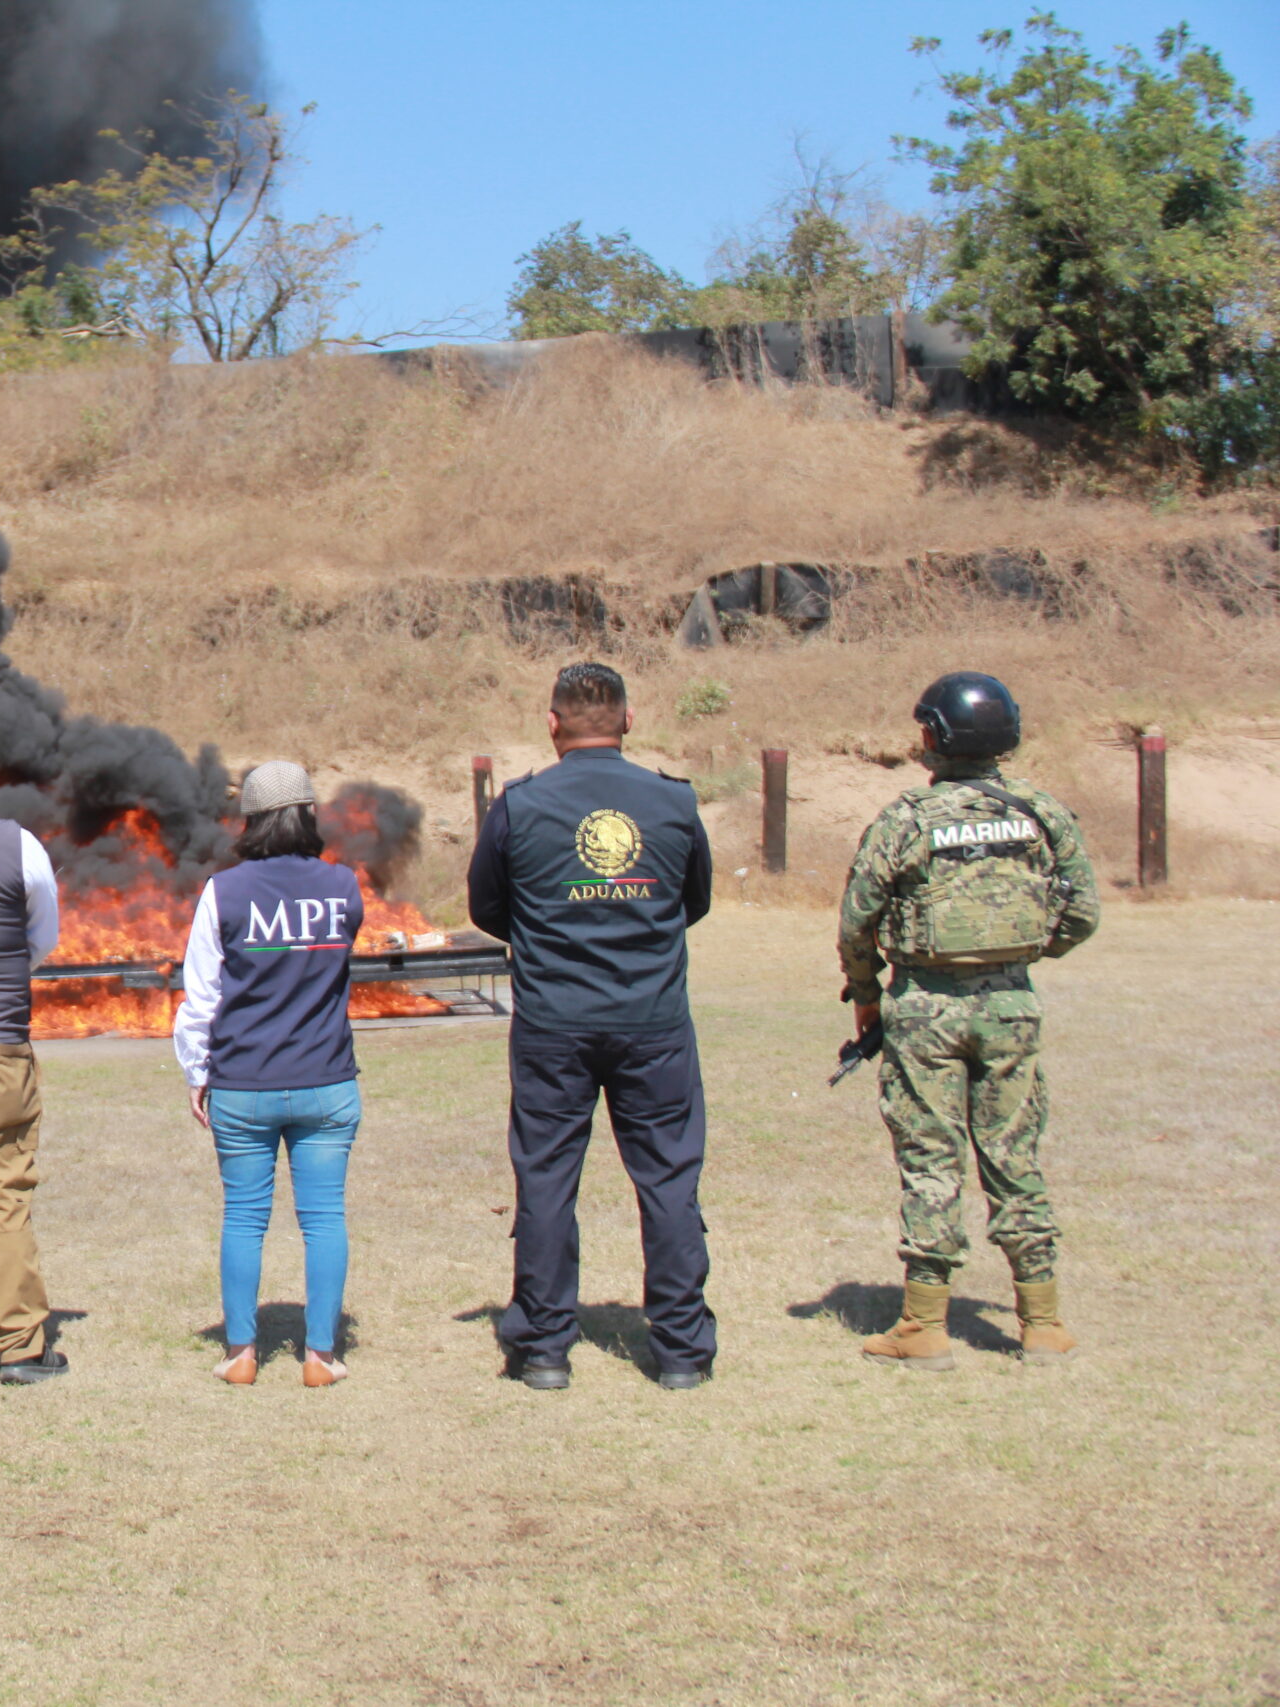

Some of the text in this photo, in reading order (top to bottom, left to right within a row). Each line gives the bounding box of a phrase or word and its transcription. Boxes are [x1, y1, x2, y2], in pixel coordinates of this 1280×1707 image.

[932, 820, 1036, 847] MARINA
[568, 884, 652, 900] ADUANA
[243, 898, 347, 943] MPF
